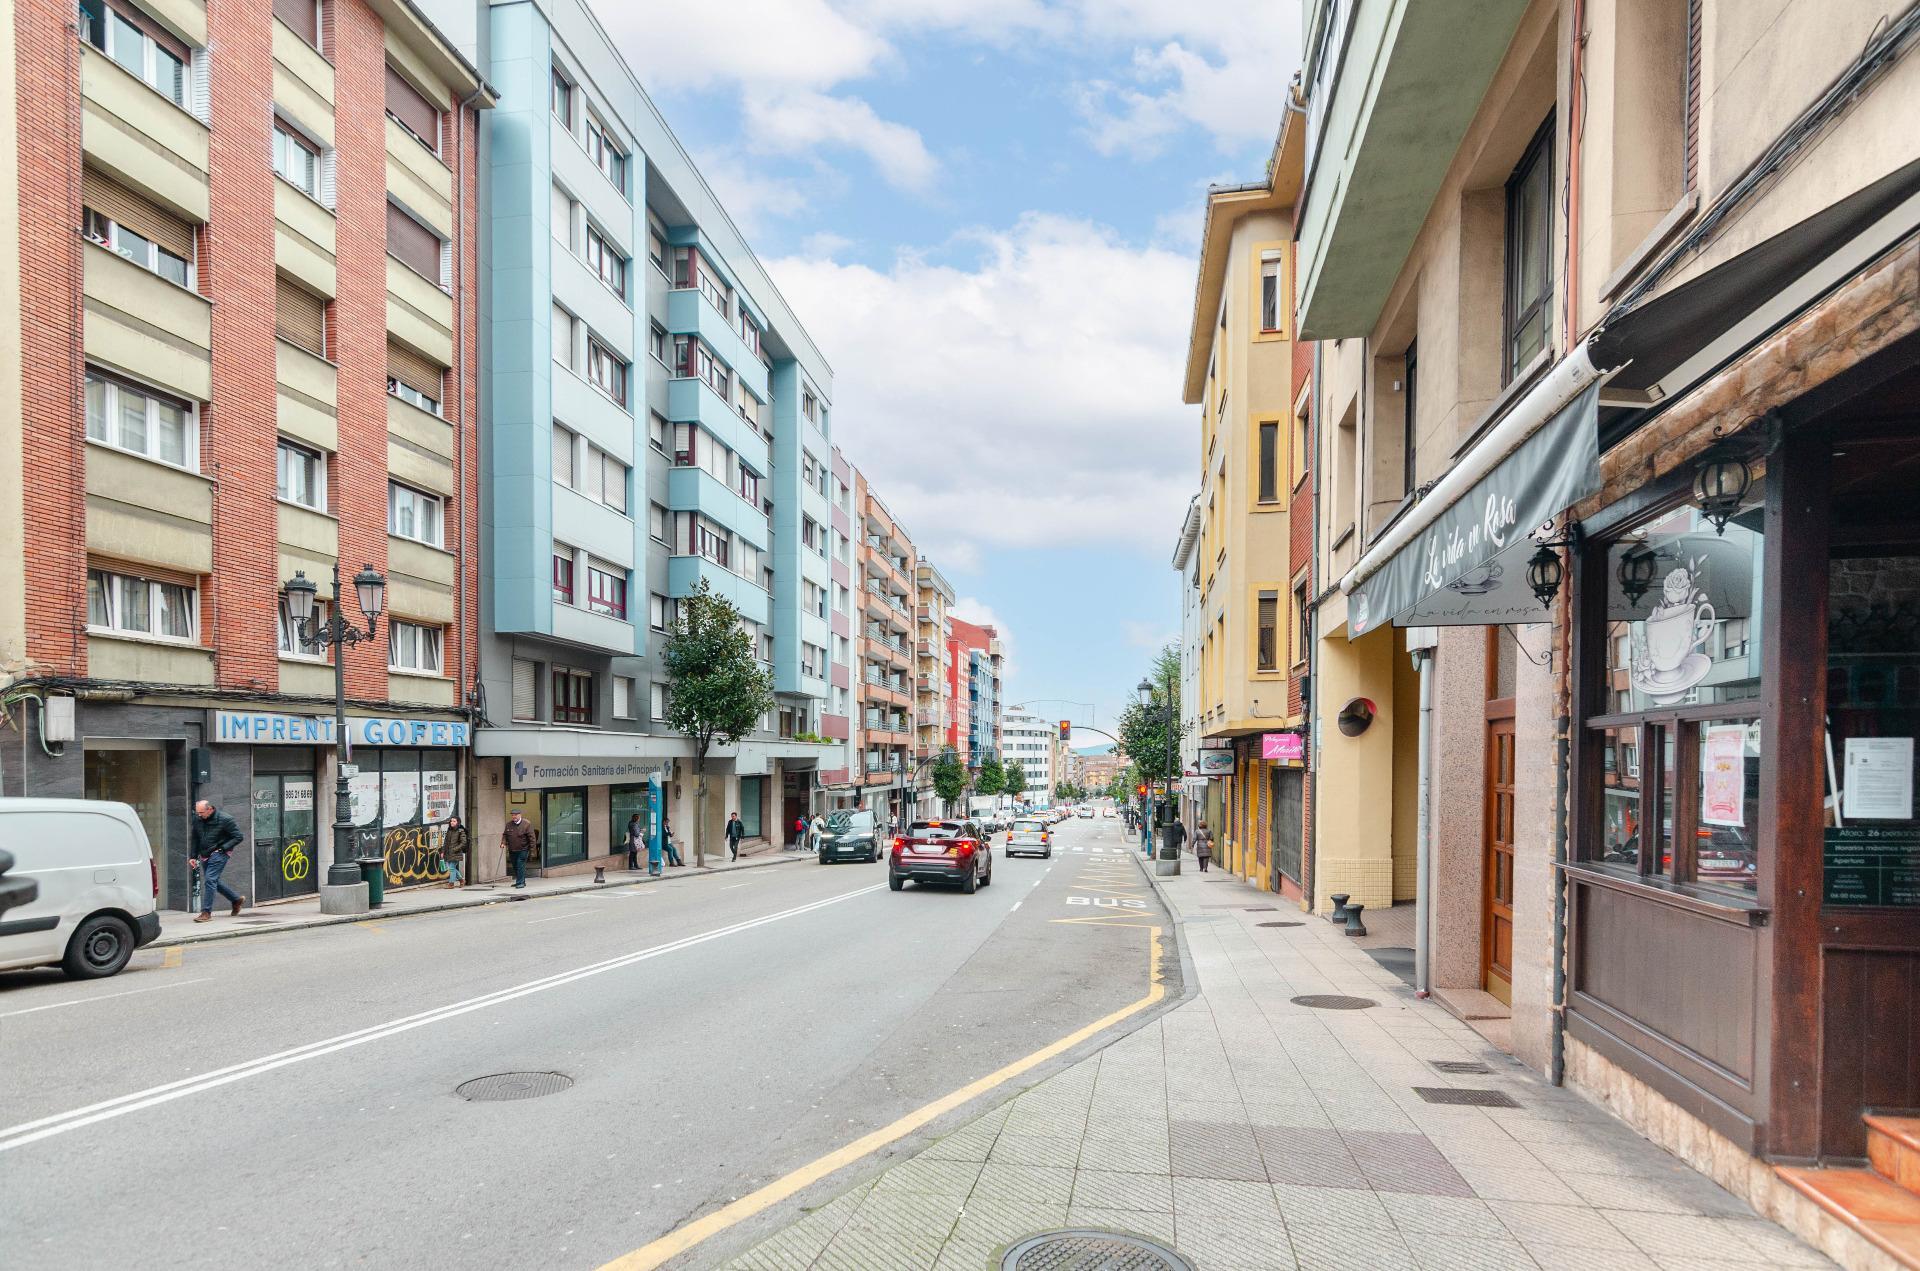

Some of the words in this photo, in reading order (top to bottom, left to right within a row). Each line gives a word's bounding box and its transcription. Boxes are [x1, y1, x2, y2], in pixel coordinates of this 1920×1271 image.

[1425, 535, 1442, 589] La
[1443, 525, 1465, 569] vida
[1469, 523, 1480, 553] en
[1484, 493, 1516, 548] Rosa
[1443, 600, 1481, 619] vida
[221, 714, 335, 741] IMPRENT
[364, 719, 467, 745] GOFER
[533, 764, 579, 778] Formación
[581, 764, 614, 777] Sanitaria
[616, 763, 627, 775] del
[628, 763, 661, 774] Principado
[1867, 829, 1880, 837] 26
[1065, 896, 1147, 908] BUS
